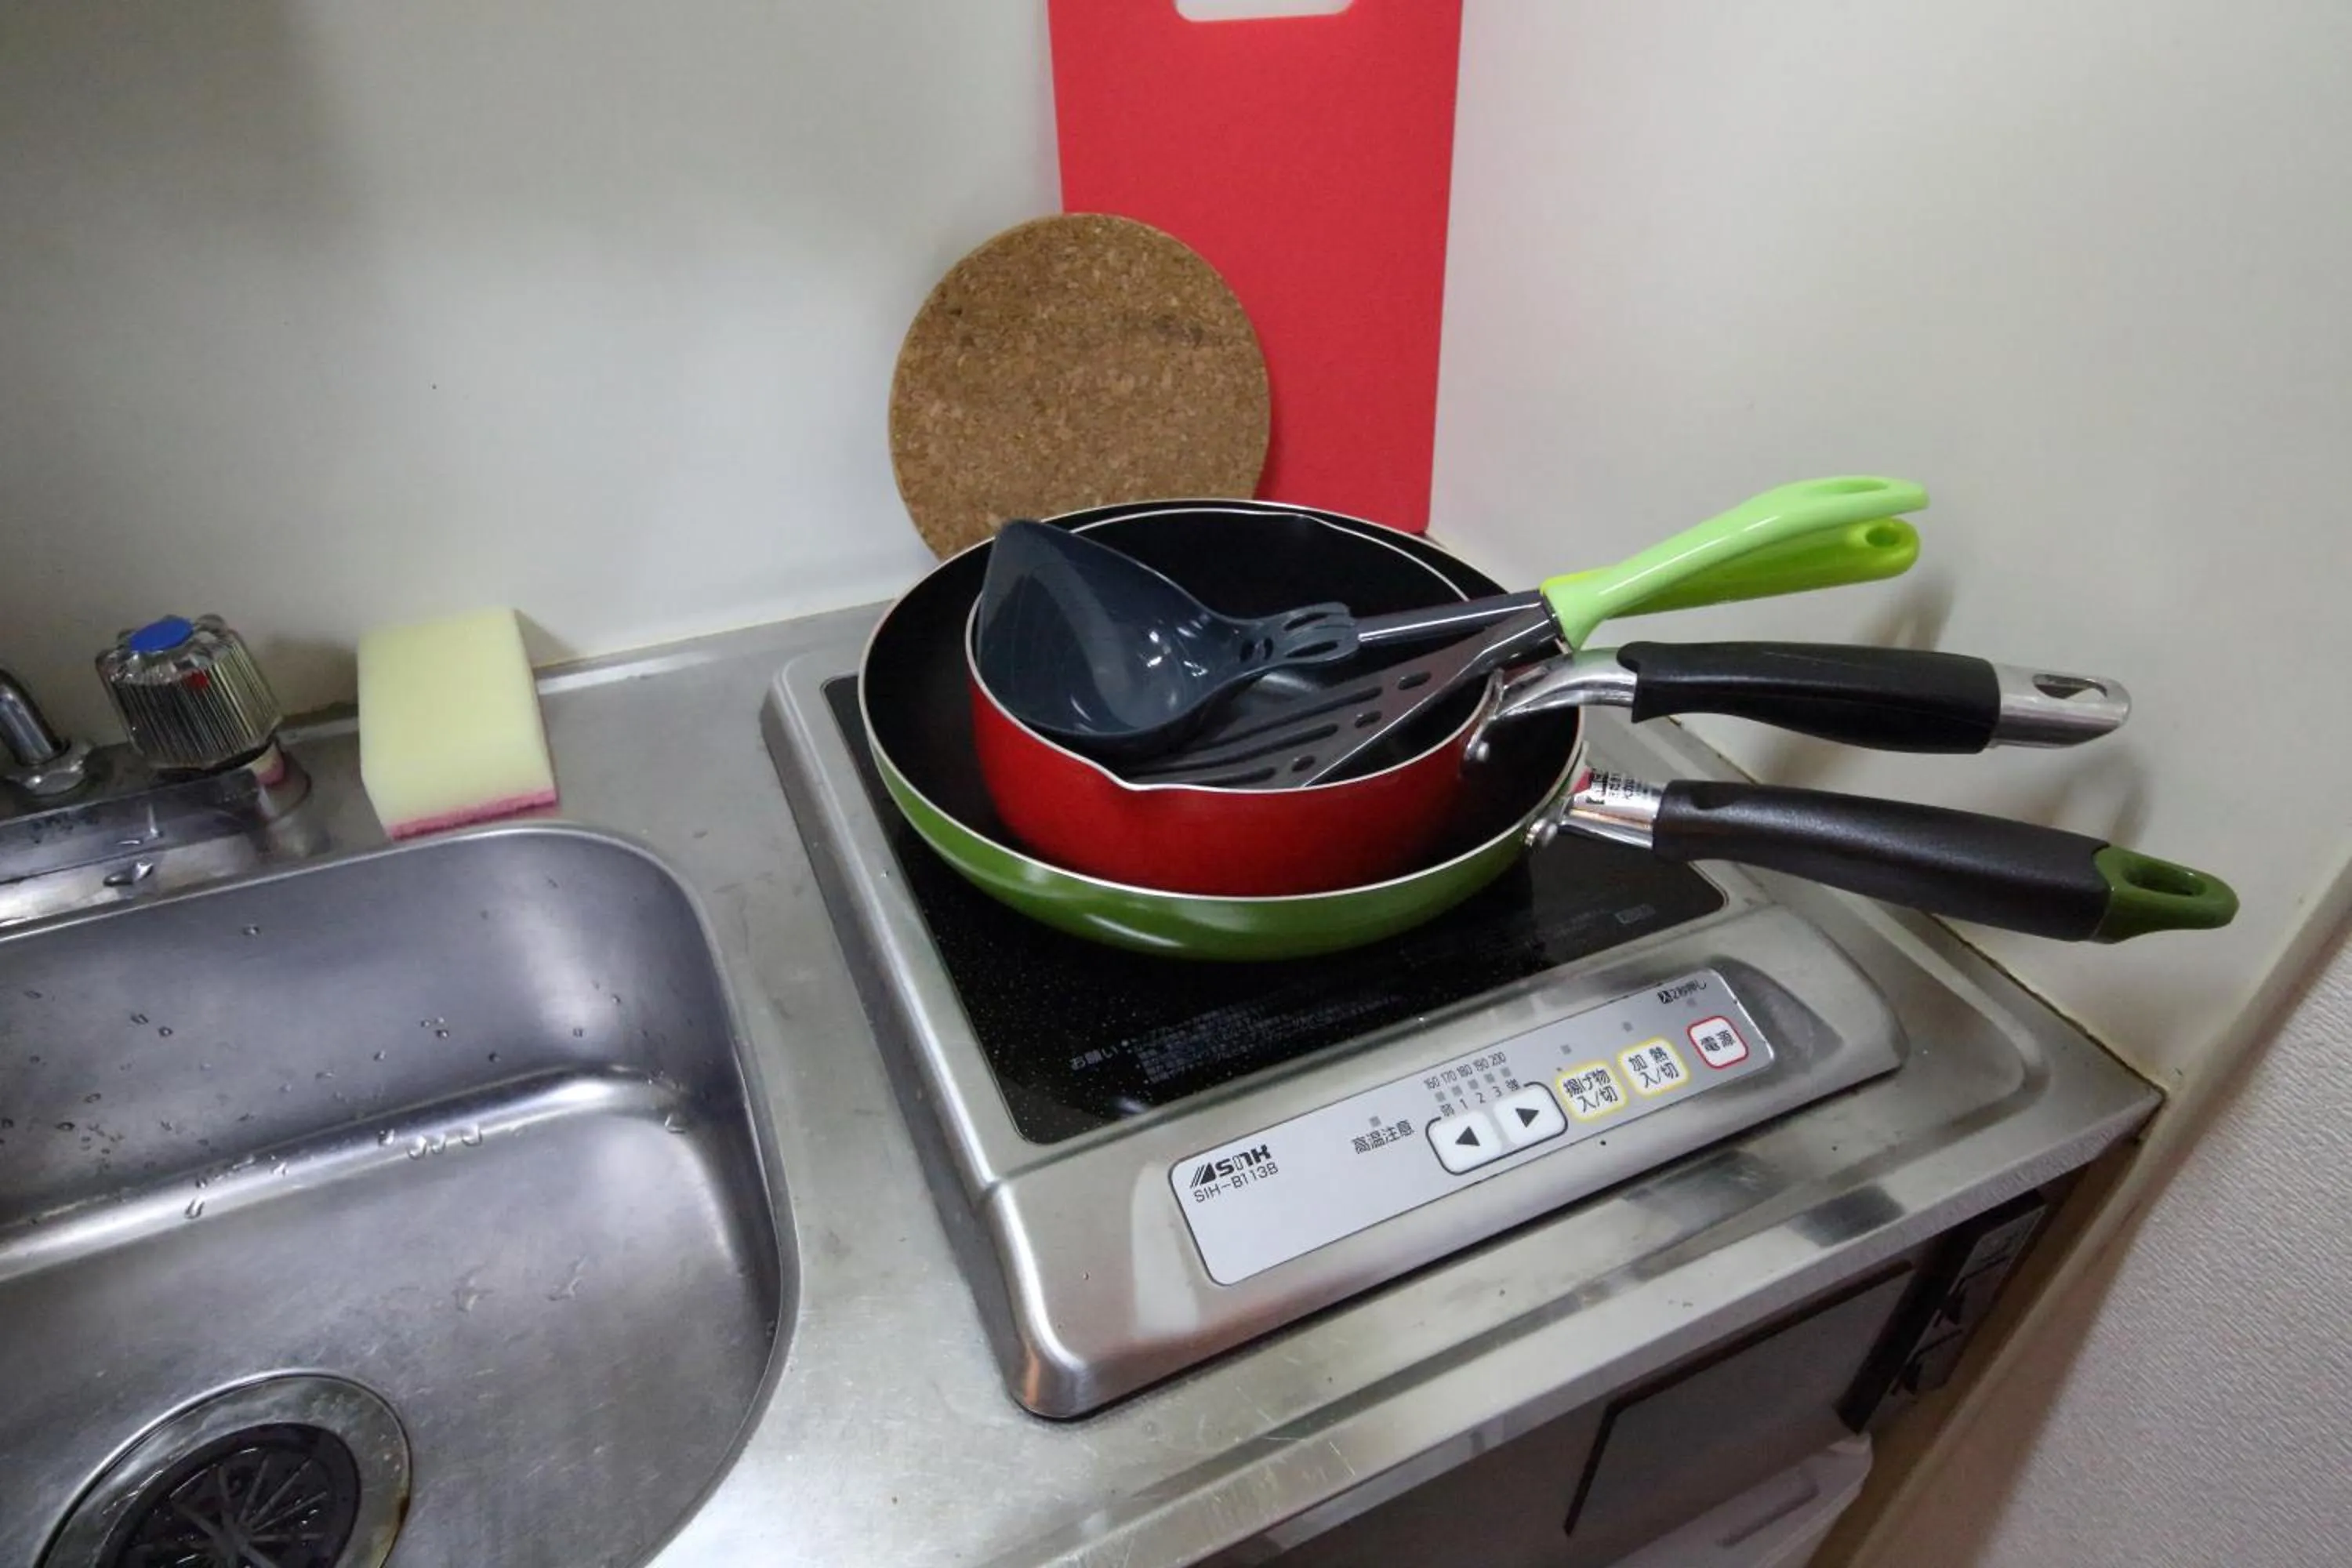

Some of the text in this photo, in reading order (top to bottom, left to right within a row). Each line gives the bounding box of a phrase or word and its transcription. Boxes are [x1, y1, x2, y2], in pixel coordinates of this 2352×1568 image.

[1700, 1030, 1736, 1051] 電源
[1628, 1046, 1668, 1072] 加熱
[1563, 1069, 1611, 1098] 揚げ物
[1352, 1120, 1414, 1154] 高温注意
[1193, 1161, 1279, 1203] SIH-B113B
